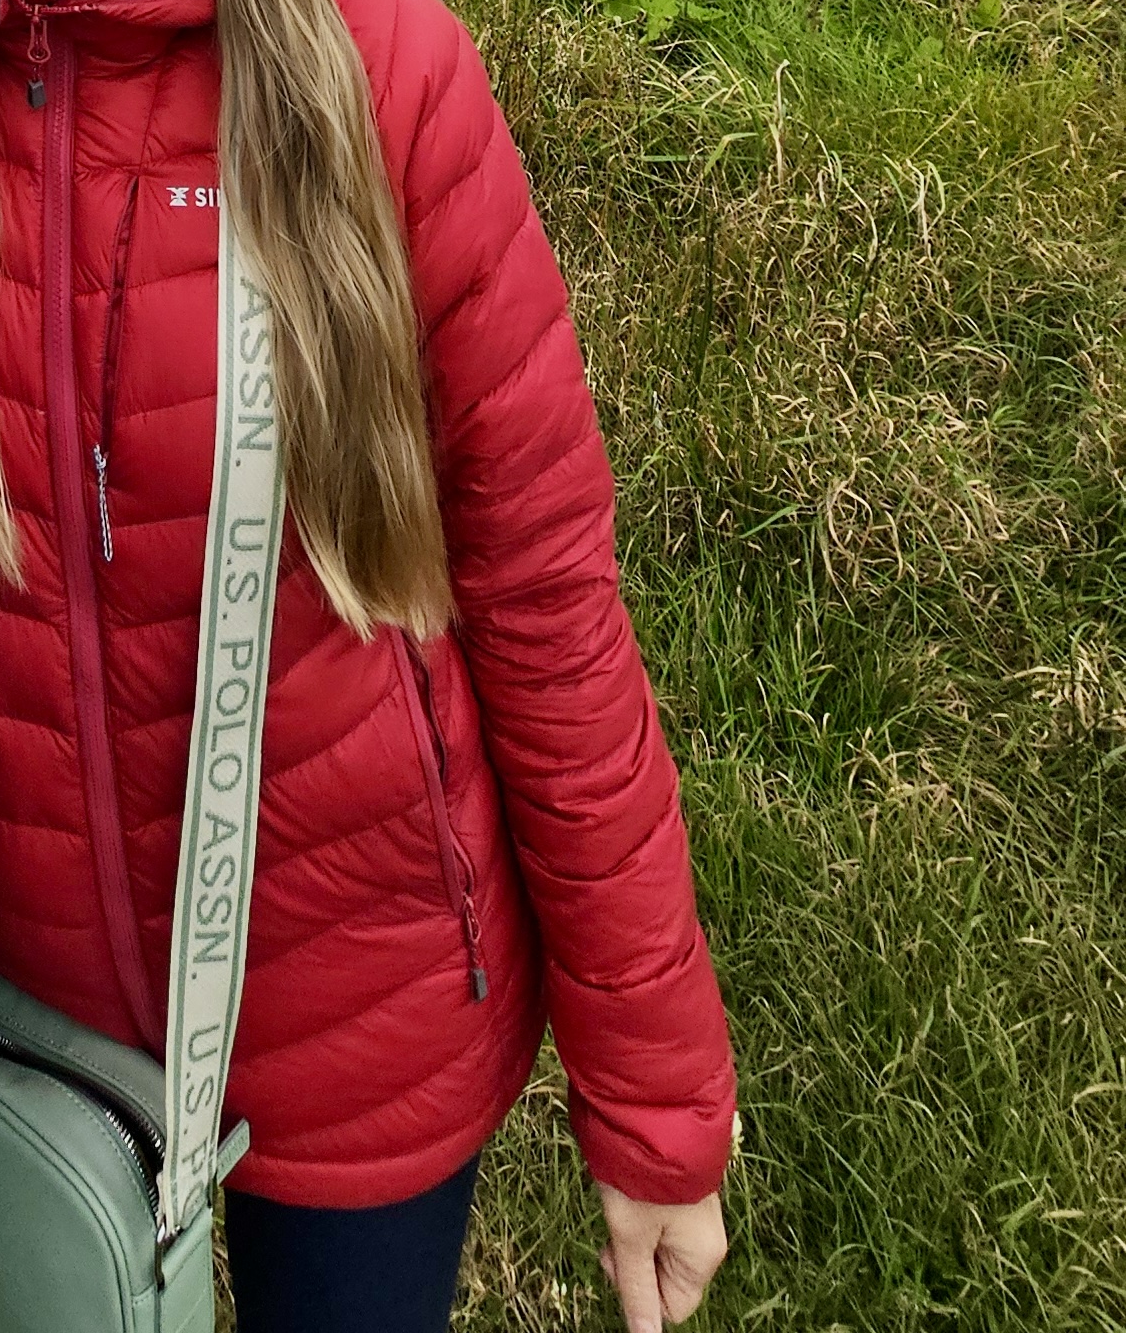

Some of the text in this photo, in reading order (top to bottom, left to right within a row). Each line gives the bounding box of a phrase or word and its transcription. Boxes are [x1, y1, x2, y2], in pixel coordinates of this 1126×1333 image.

[235, 276, 273, 468] ASSN.
[221, 517, 266, 621] U.S.
[208, 637, 254, 793] POLO
[191, 809, 239, 981] ASSN.
[183, 1023, 221, 1136] U.S.
